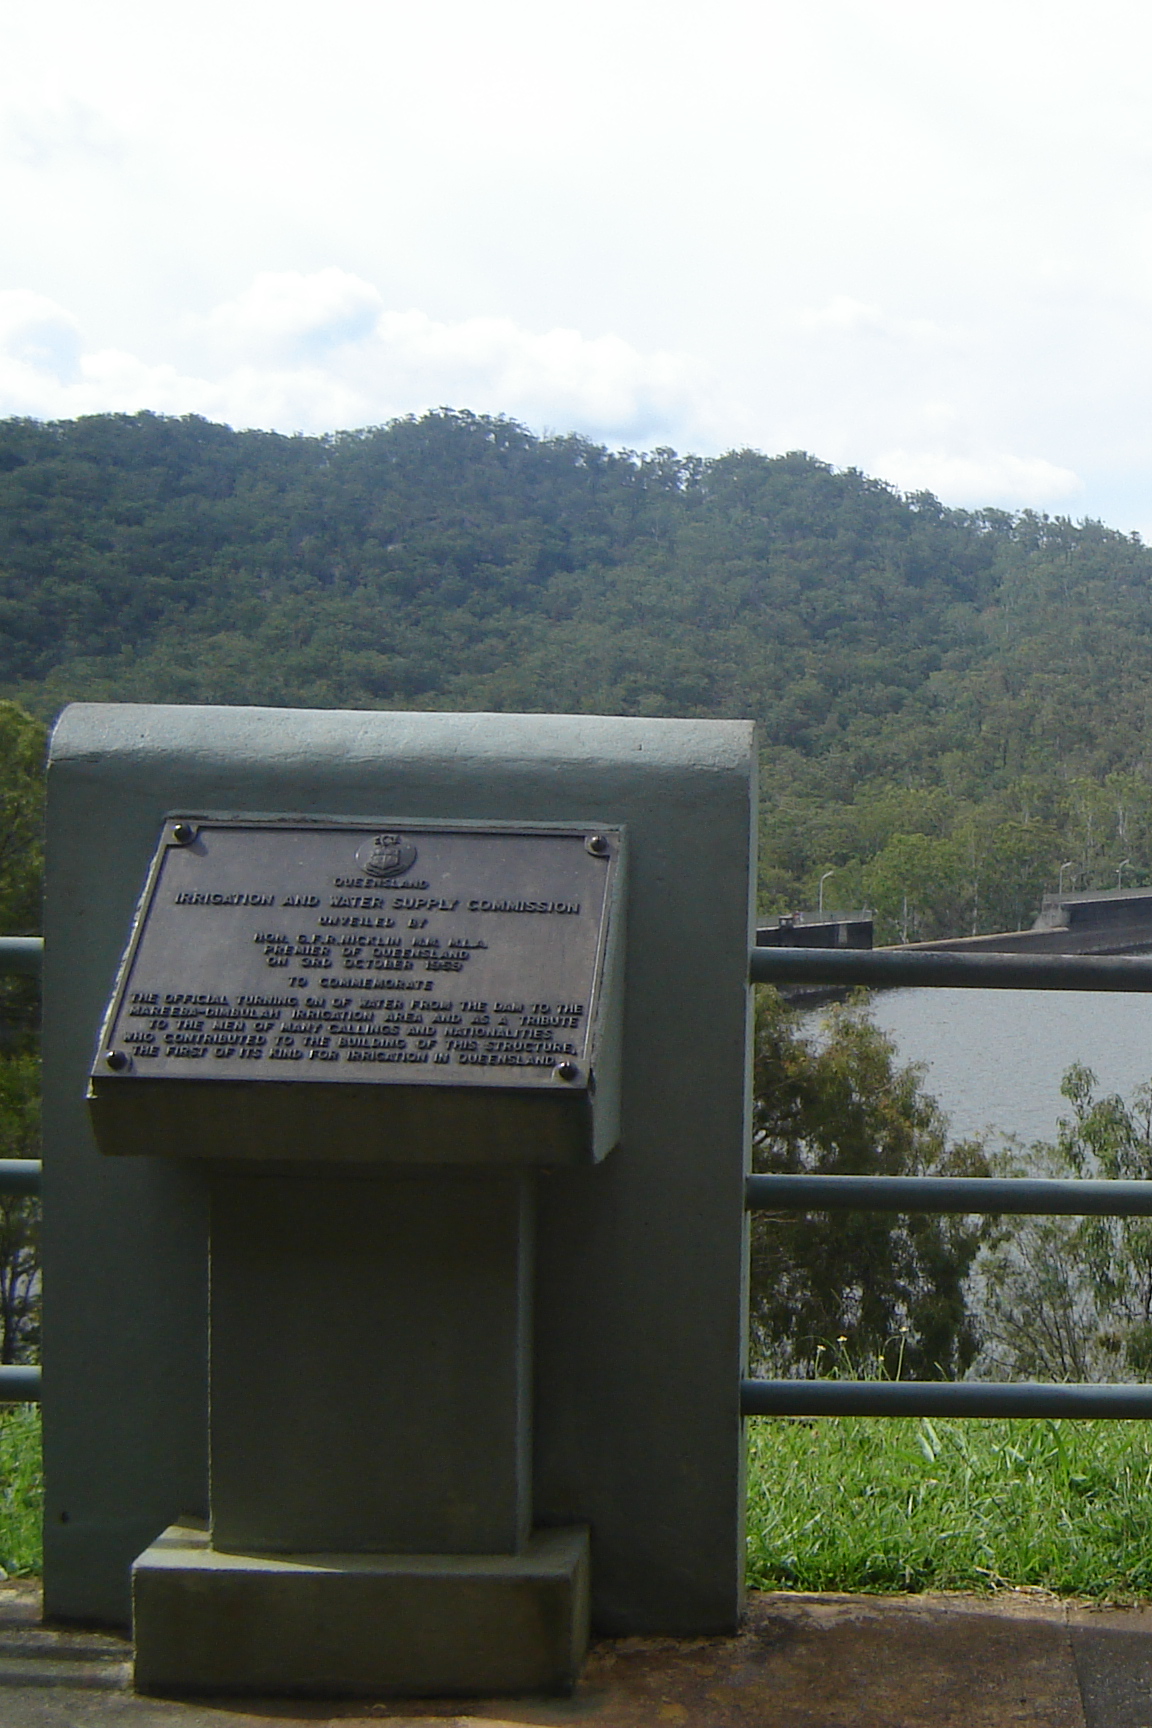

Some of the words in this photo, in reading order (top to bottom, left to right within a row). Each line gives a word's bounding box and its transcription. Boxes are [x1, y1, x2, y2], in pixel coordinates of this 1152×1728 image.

[334, 878, 430, 889] QUEENSLAND
[175, 892, 275, 906] IRRIGATION
[282, 895, 321, 907] AND
[330, 896, 384, 908] WATER
[392, 898, 460, 911] SUPPLY
[467, 900, 581, 915] COMMISSION
[319, 916, 395, 927] UNVEILED
[408, 919, 429, 928] BY
[264, 946, 331, 956] PREMIER
[342, 947, 362, 957] OF
[373, 949, 470, 960] QUEENSLAND
[266, 957, 289, 967] ON
[301, 958, 333, 968] 3RD
[343, 960, 414, 971] OCTOBER
[289, 977, 308, 988] TO
[319, 978, 434, 991] COMMEMORATE
[130, 993, 159, 1004] THE
[164, 994, 230, 1005] OFFICIAL
[237, 995, 298, 1006] TURNING
[304, 997, 325, 1007] ON
[331, 997, 352, 1008] OF
[360, 999, 403, 1009] WATER
[411, 1000, 452, 1011] FROM
[460, 1001, 488, 1012] THE
[493, 1002, 524, 1012] DAM
[531, 1003, 550, 1013] TO
[557, 1003, 584, 1015] THE
[129, 1005, 280, 1019] MAREEBA-DIMBULAH
[291, 1009, 374, 1021] IRRIGATION
[384, 1011, 424, 1023] AREA
[432, 1012, 463, 1024] AND
[471, 1014, 490, 1025] AS
[497, 1015, 509, 1025] A
[519, 1016, 579, 1028] TRIBUTE
[149, 1020, 169, 1030] TO
[176, 1020, 204, 1031] THE
[212, 1021, 246, 1032] MEN
[253, 1022, 274, 1032] OF
[280, 1023, 324, 1033] MANY
[328, 1023, 400, 1036] CALLINGS
[406, 1025, 437, 1037] AND
[444, 1026, 554, 1040] NATIONALITIES
[123, 1031, 155, 1043] WHO
[163, 1032, 268, 1046] CONTRIBUTED
[274, 1035, 294, 1046] TO
[302, 1036, 332, 1047] THE
[338, 1036, 407, 1049] BUILDING
[417, 1039, 437, 1050] OF
[444, 1040, 480, 1051] THIS
[132, 1045, 160, 1057] THE
[166, 1046, 208, 1058] FIRST
[215, 1047, 236, 1058] OF
[239, 1048, 263, 1059] ITS
[269, 1048, 303, 1060] KIND
[309, 1049, 340, 1061] FOR
[346, 1050, 429, 1063] IRRIGATION
[434, 1052, 450, 1063] IN
